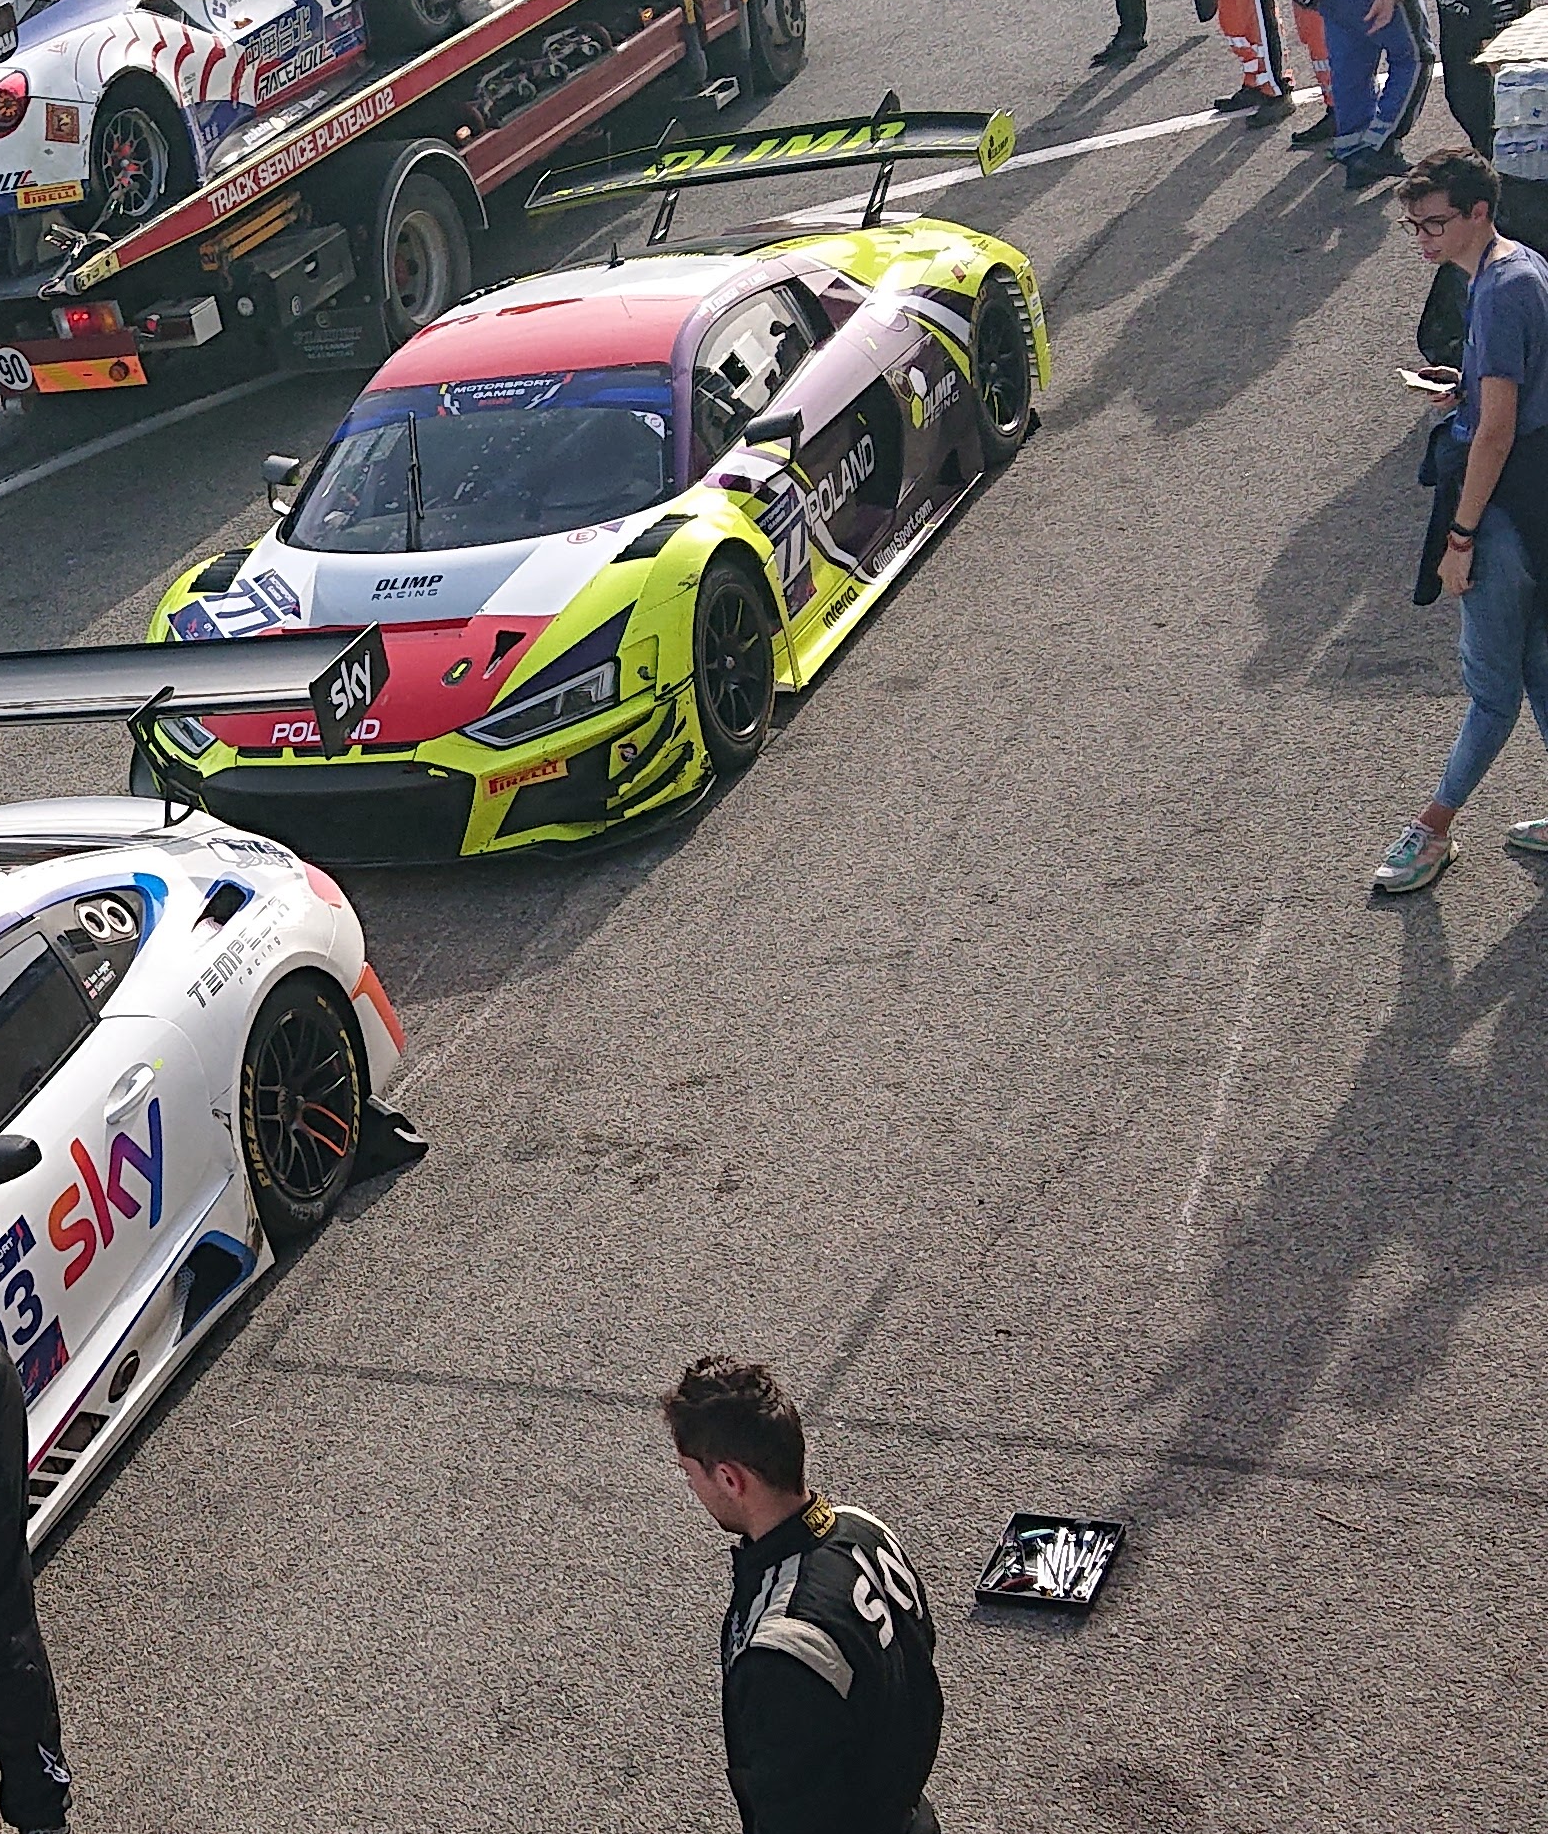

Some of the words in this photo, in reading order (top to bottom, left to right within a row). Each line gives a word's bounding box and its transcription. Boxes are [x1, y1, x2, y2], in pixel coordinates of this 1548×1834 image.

[207, 169, 261, 218] TRACK
[257, 138, 317, 187] SERVICE
[315, 101, 375, 156] PLATEAU
[374, 87, 397, 116] 02
[23, 184, 77, 204] PIRELLI
[453, 378, 555, 395] MOTORSPORT
[472, 388, 526, 400] GAMES
[923, 368, 956, 417] OLIMP
[805, 432, 875, 535] POLAND
[371, 588, 439, 601] RACING
[375, 574, 443, 591] OLIMP
[329, 649, 371, 721] sky
[271, 718, 381, 744] POLND
[487, 760, 559, 797] PIRELLI
[238, 935, 282, 985] racing
[47, 1097, 164, 1291] sky
[851, 1531, 924, 1651] sky
